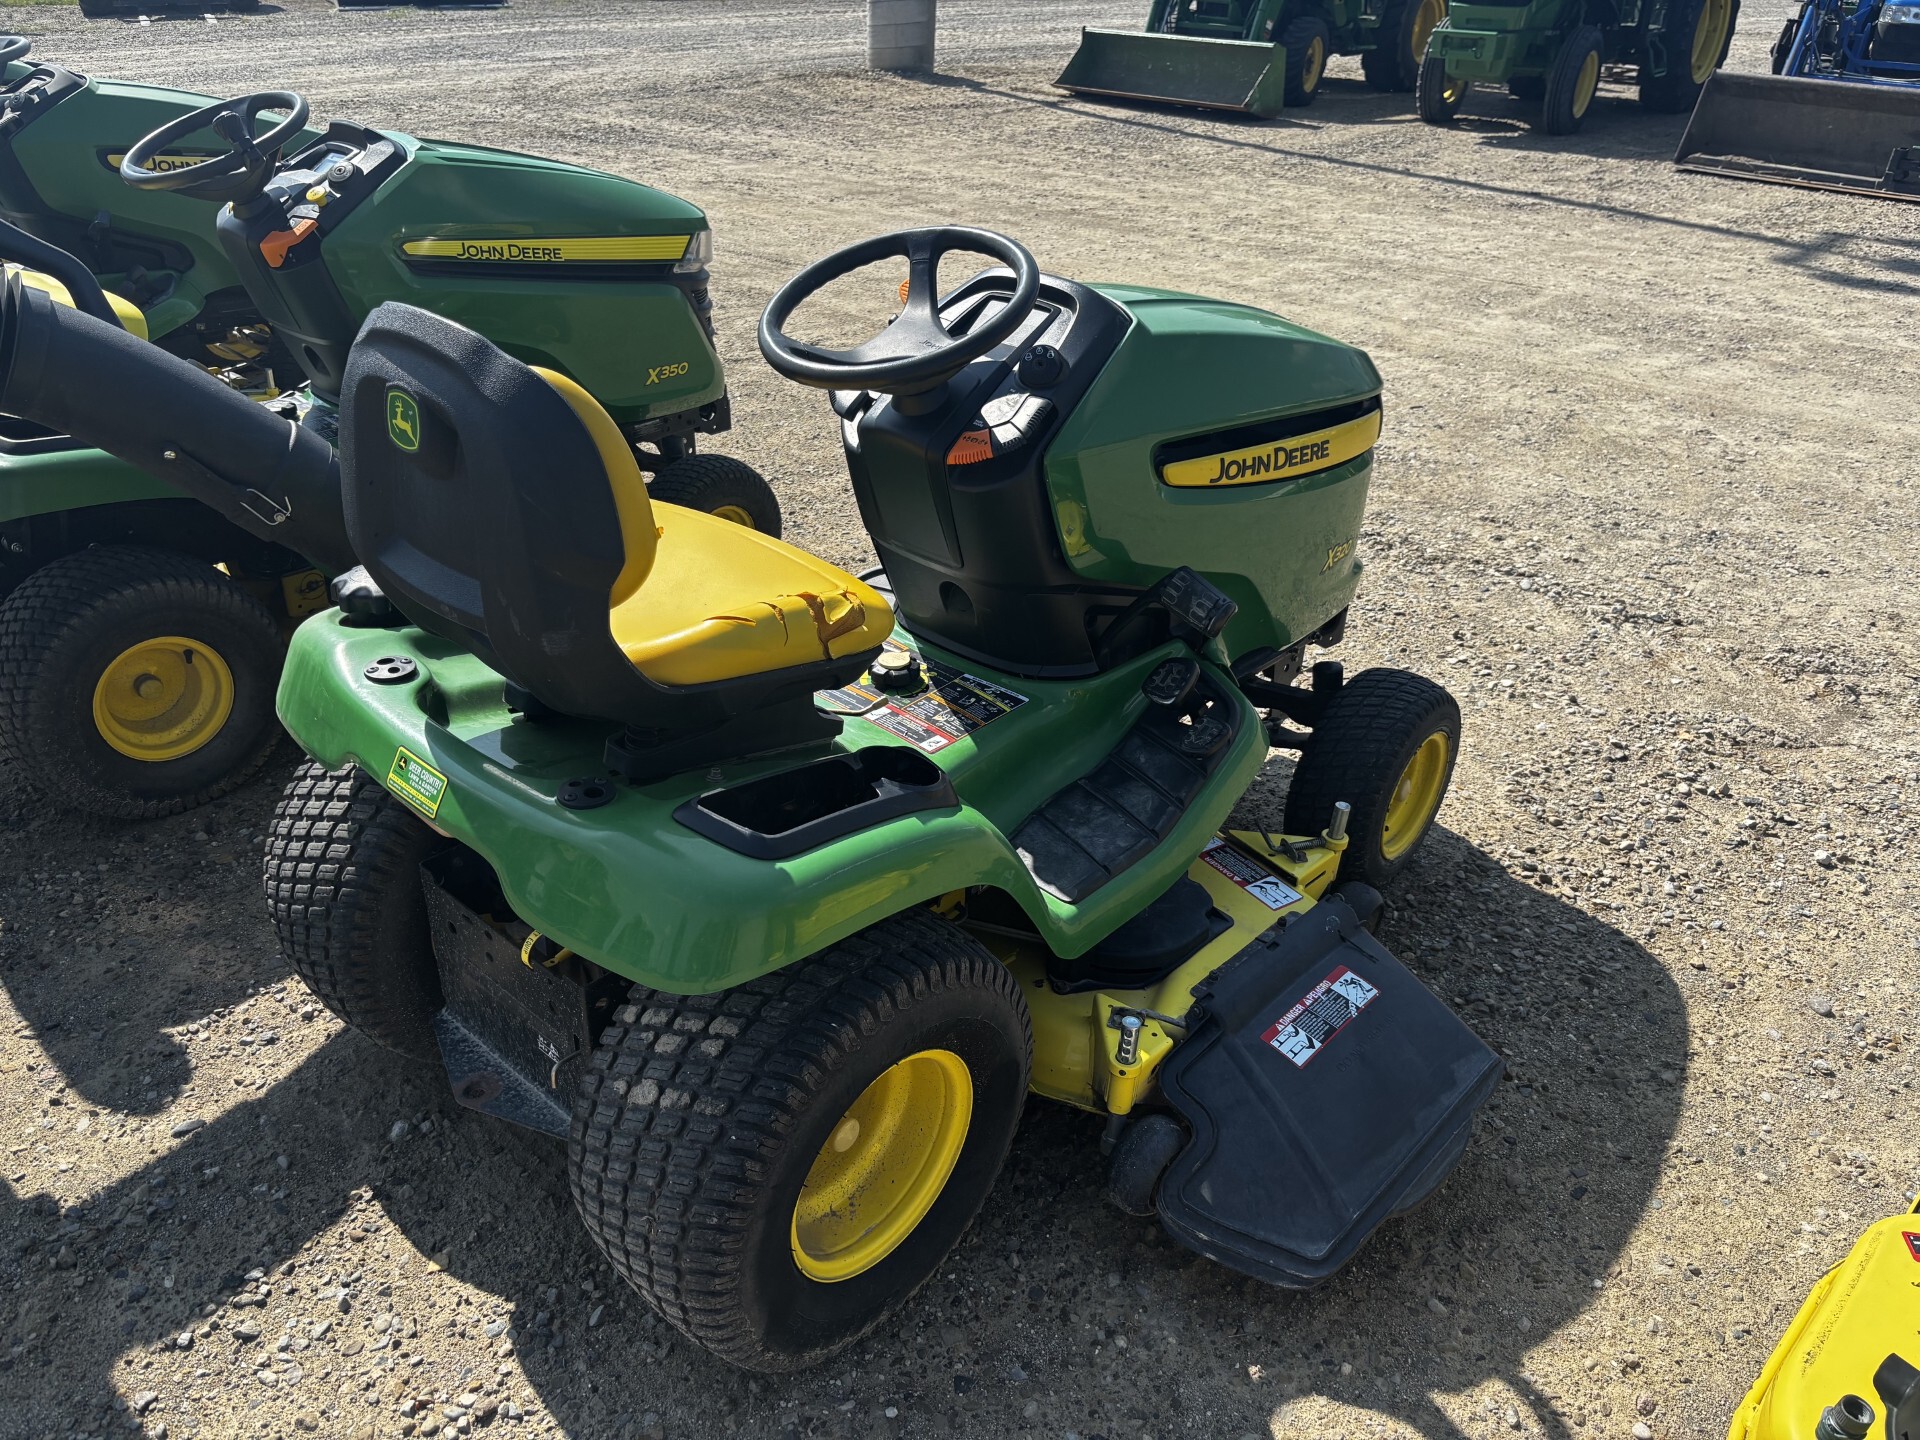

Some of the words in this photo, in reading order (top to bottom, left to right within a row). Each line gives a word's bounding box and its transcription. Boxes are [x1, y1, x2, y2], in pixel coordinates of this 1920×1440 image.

[456, 242, 505, 258] JOHN
[508, 244, 563, 260] DEERE
[644, 361, 689, 386] X350
[1209, 453, 1272, 484] JOHN
[1273, 439, 1330, 471] DEERE
[420, 769, 443, 790] COUNTRY
[1204, 856, 1234, 878] DANGER
[1279, 1003, 1306, 1026] DANGER
[1308, 979, 1332, 1003] PELIGRO
